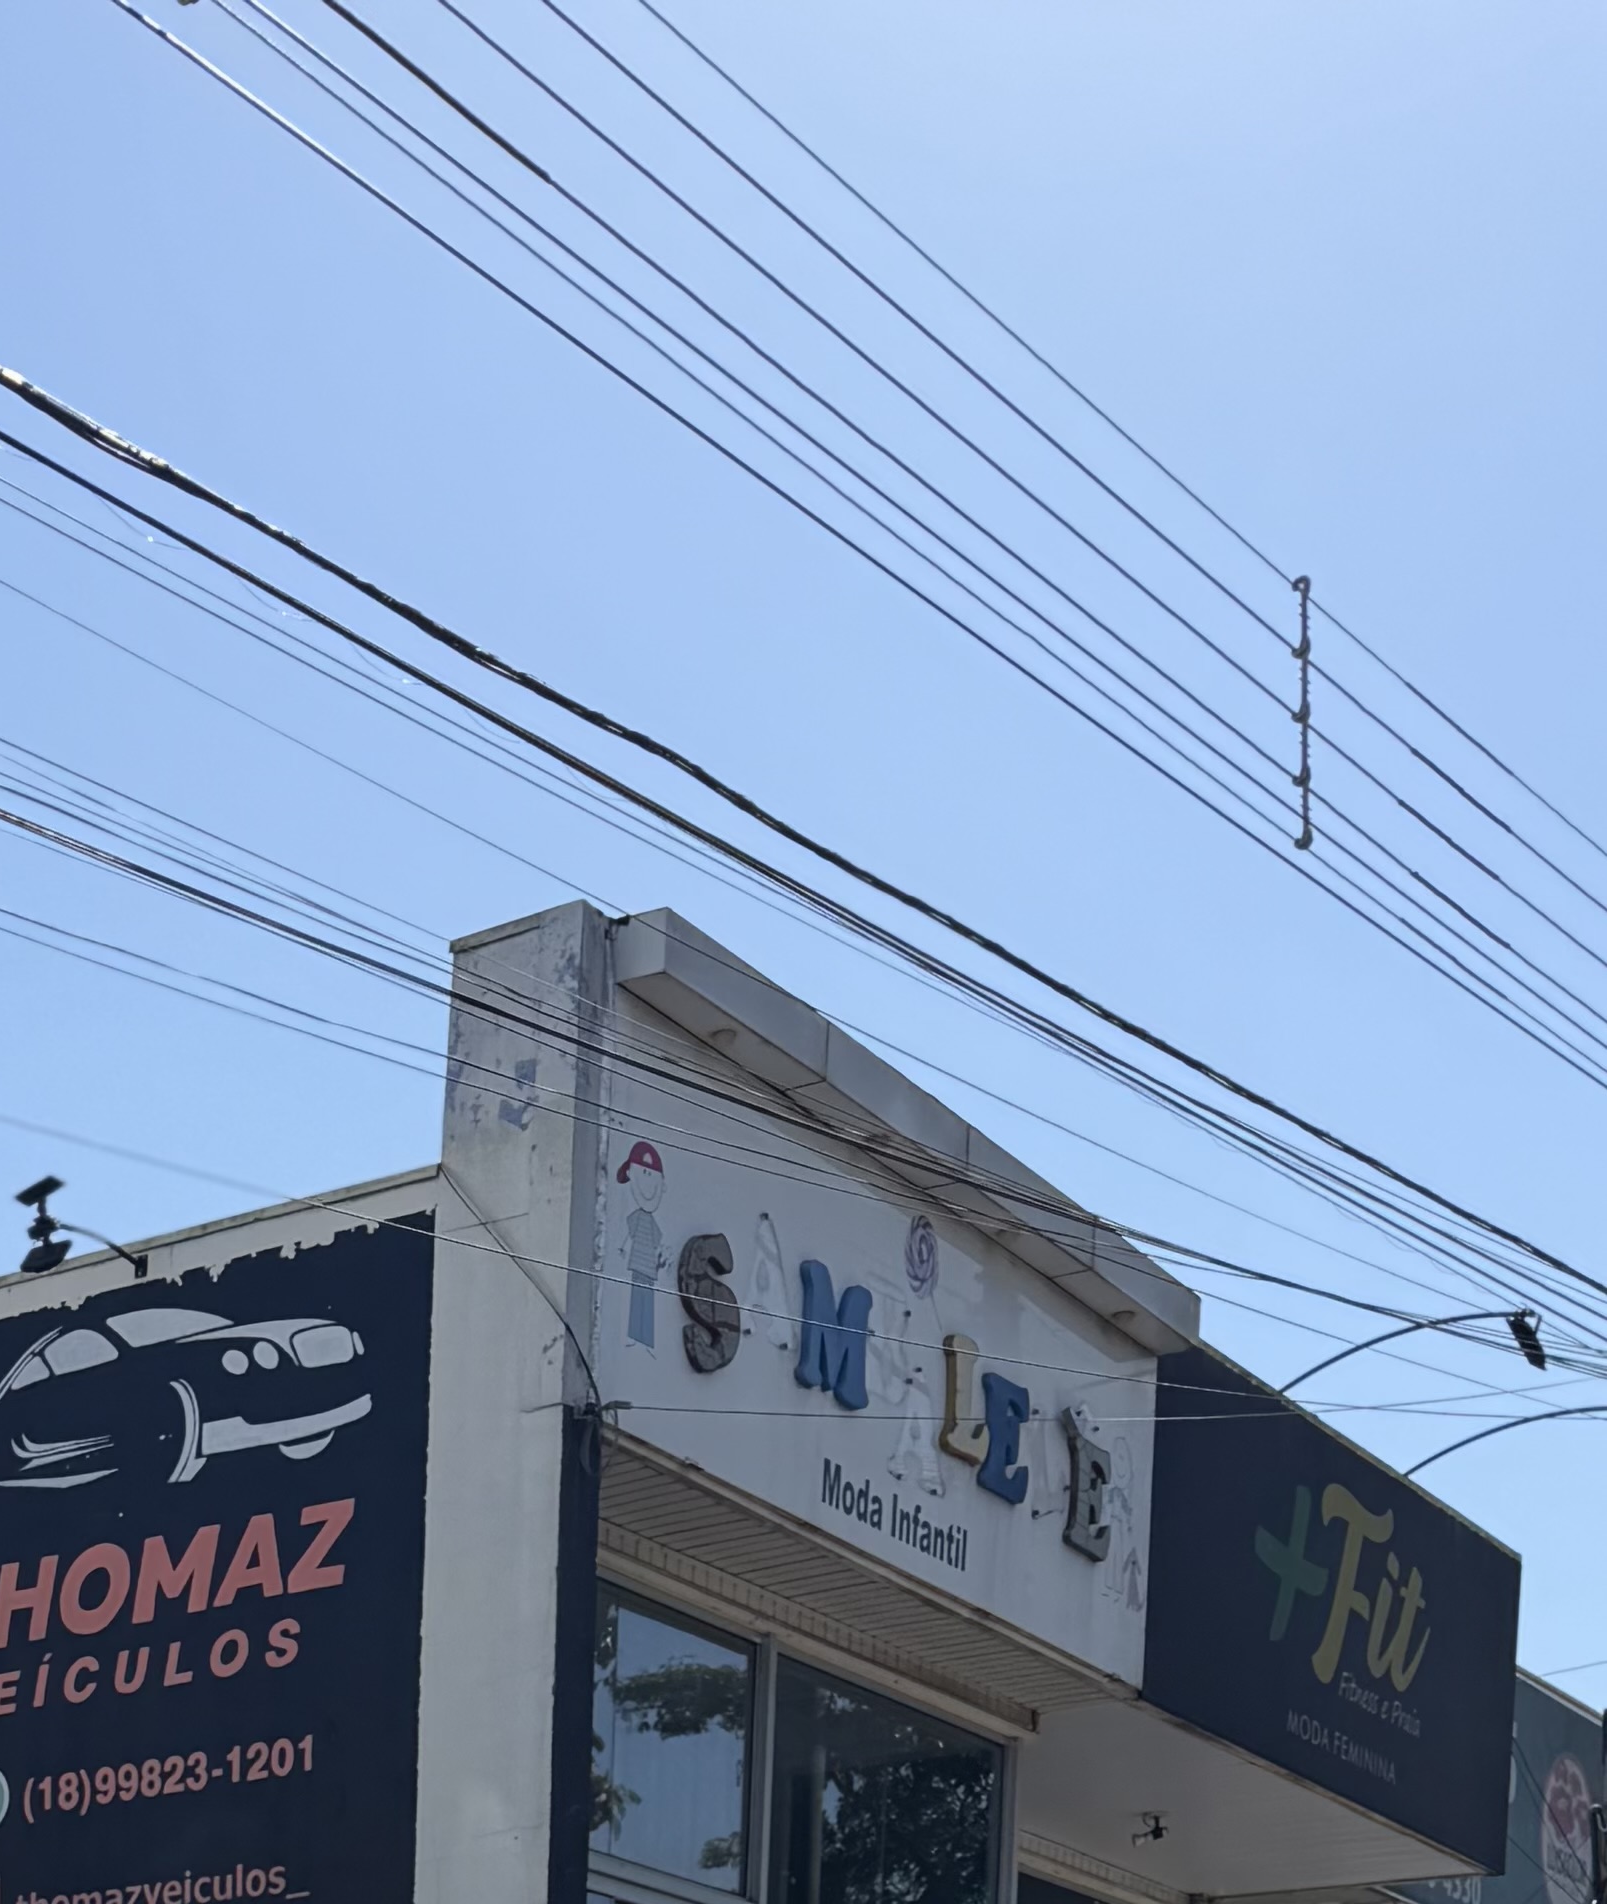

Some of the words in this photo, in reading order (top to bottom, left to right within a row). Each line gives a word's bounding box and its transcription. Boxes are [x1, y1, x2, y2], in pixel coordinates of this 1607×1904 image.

[821, 1456, 883, 1532] Moda
[890, 1493, 968, 1572] Infantil
[22, 1733, 315, 1824] (18)99823-1201
[1286, 1708, 1330, 1752] MODA
[1332, 1730, 1396, 1785] FEMININA
